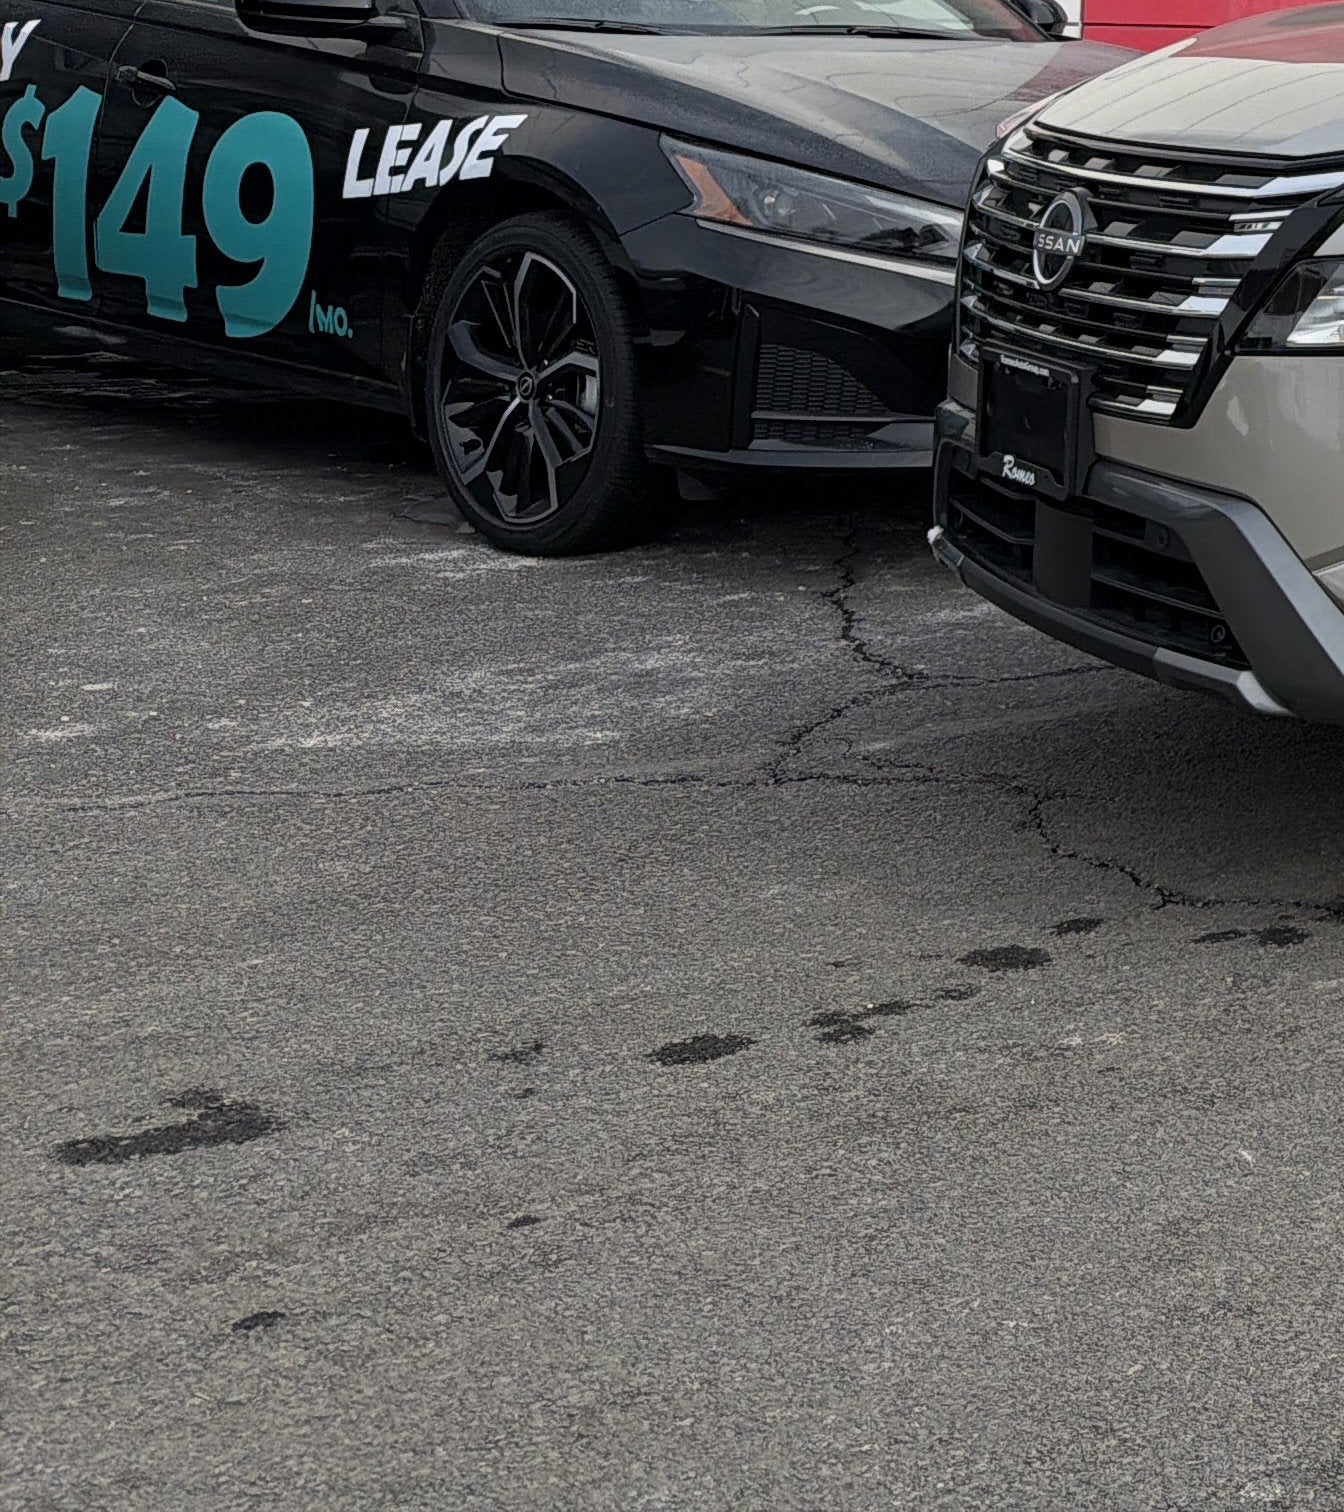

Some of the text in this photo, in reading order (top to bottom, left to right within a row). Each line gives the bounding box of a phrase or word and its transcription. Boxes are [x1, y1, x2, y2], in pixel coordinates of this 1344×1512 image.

[342, 114, 528, 199] LEASE
[0, 84, 314, 338] $149
[309, 290, 354, 339] /MO.
